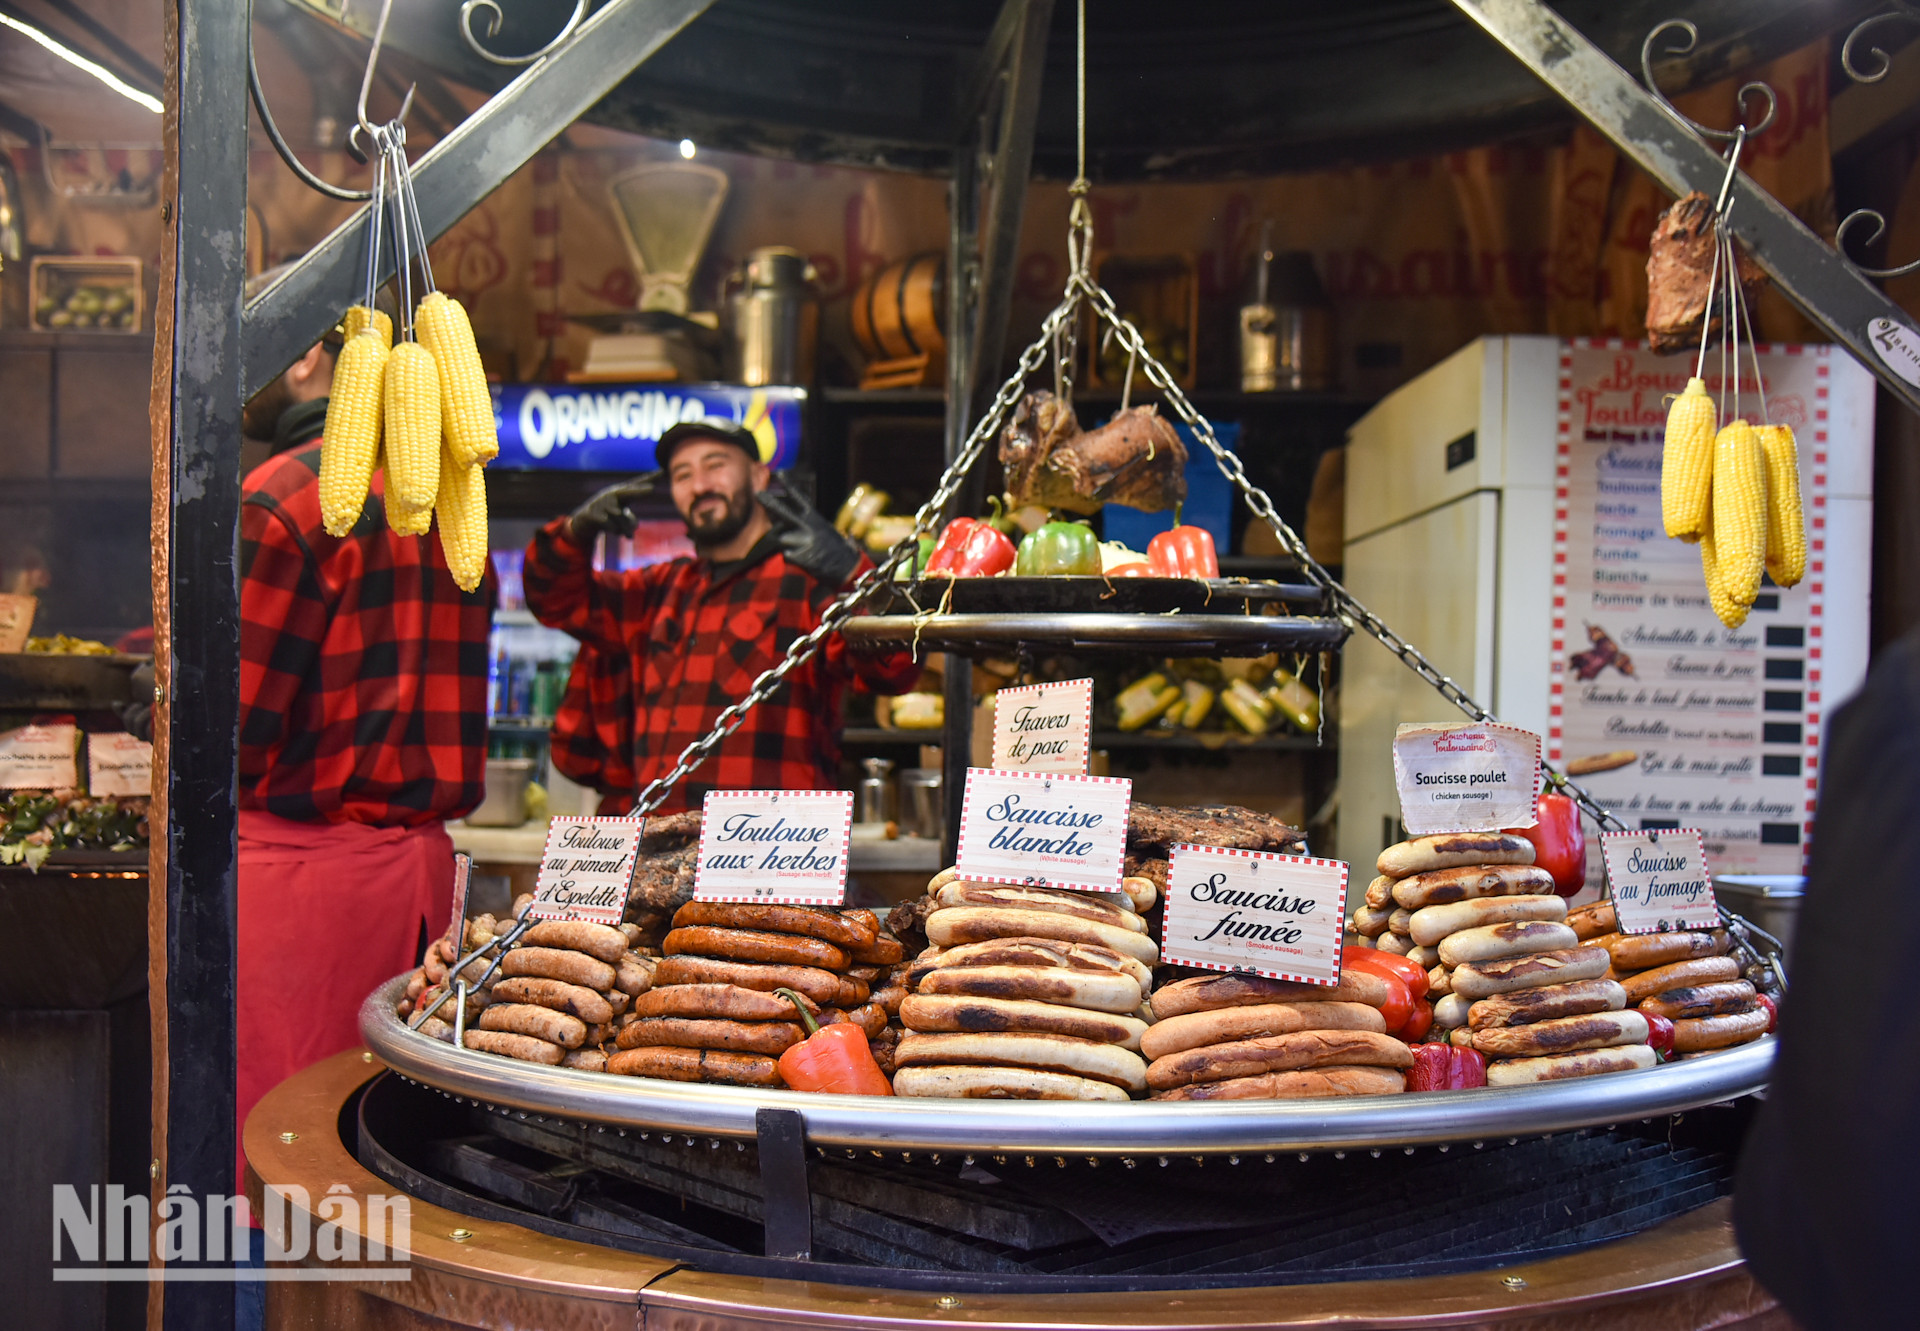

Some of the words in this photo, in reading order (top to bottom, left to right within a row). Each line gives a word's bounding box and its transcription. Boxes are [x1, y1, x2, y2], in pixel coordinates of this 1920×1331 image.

[1875, 326, 1920, 368] LIBATH
[1010, 706, 1070, 733] Travers
[1007, 735, 1027, 759] de
[1020, 739, 1069, 764] porc
[1433, 740, 1484, 752] Toulousaine
[1416, 772, 1467, 785] Saucisse
[1470, 770, 1507, 786] poulet
[986, 794, 1103, 828] Saucisse
[558, 825, 625, 850] Toulouse
[717, 814, 830, 842] Toulouse
[988, 826, 1094, 856] blanche
[547, 857, 568, 870] au
[560, 853, 629, 878] piment
[706, 854, 754, 869] aux
[758, 846, 838, 871] herbes
[1628, 847, 1688, 873] Saucisse
[539, 880, 619, 910] d'Espelette
[1190, 873, 1316, 914] Saucisse
[1620, 885, 1640, 900] au
[1640, 875, 1707, 907] fromage
[1194, 911, 1302, 944] fumée
[1246, 940, 1274, 951] (Smoked
[1274, 946, 1304, 956] sausage)
